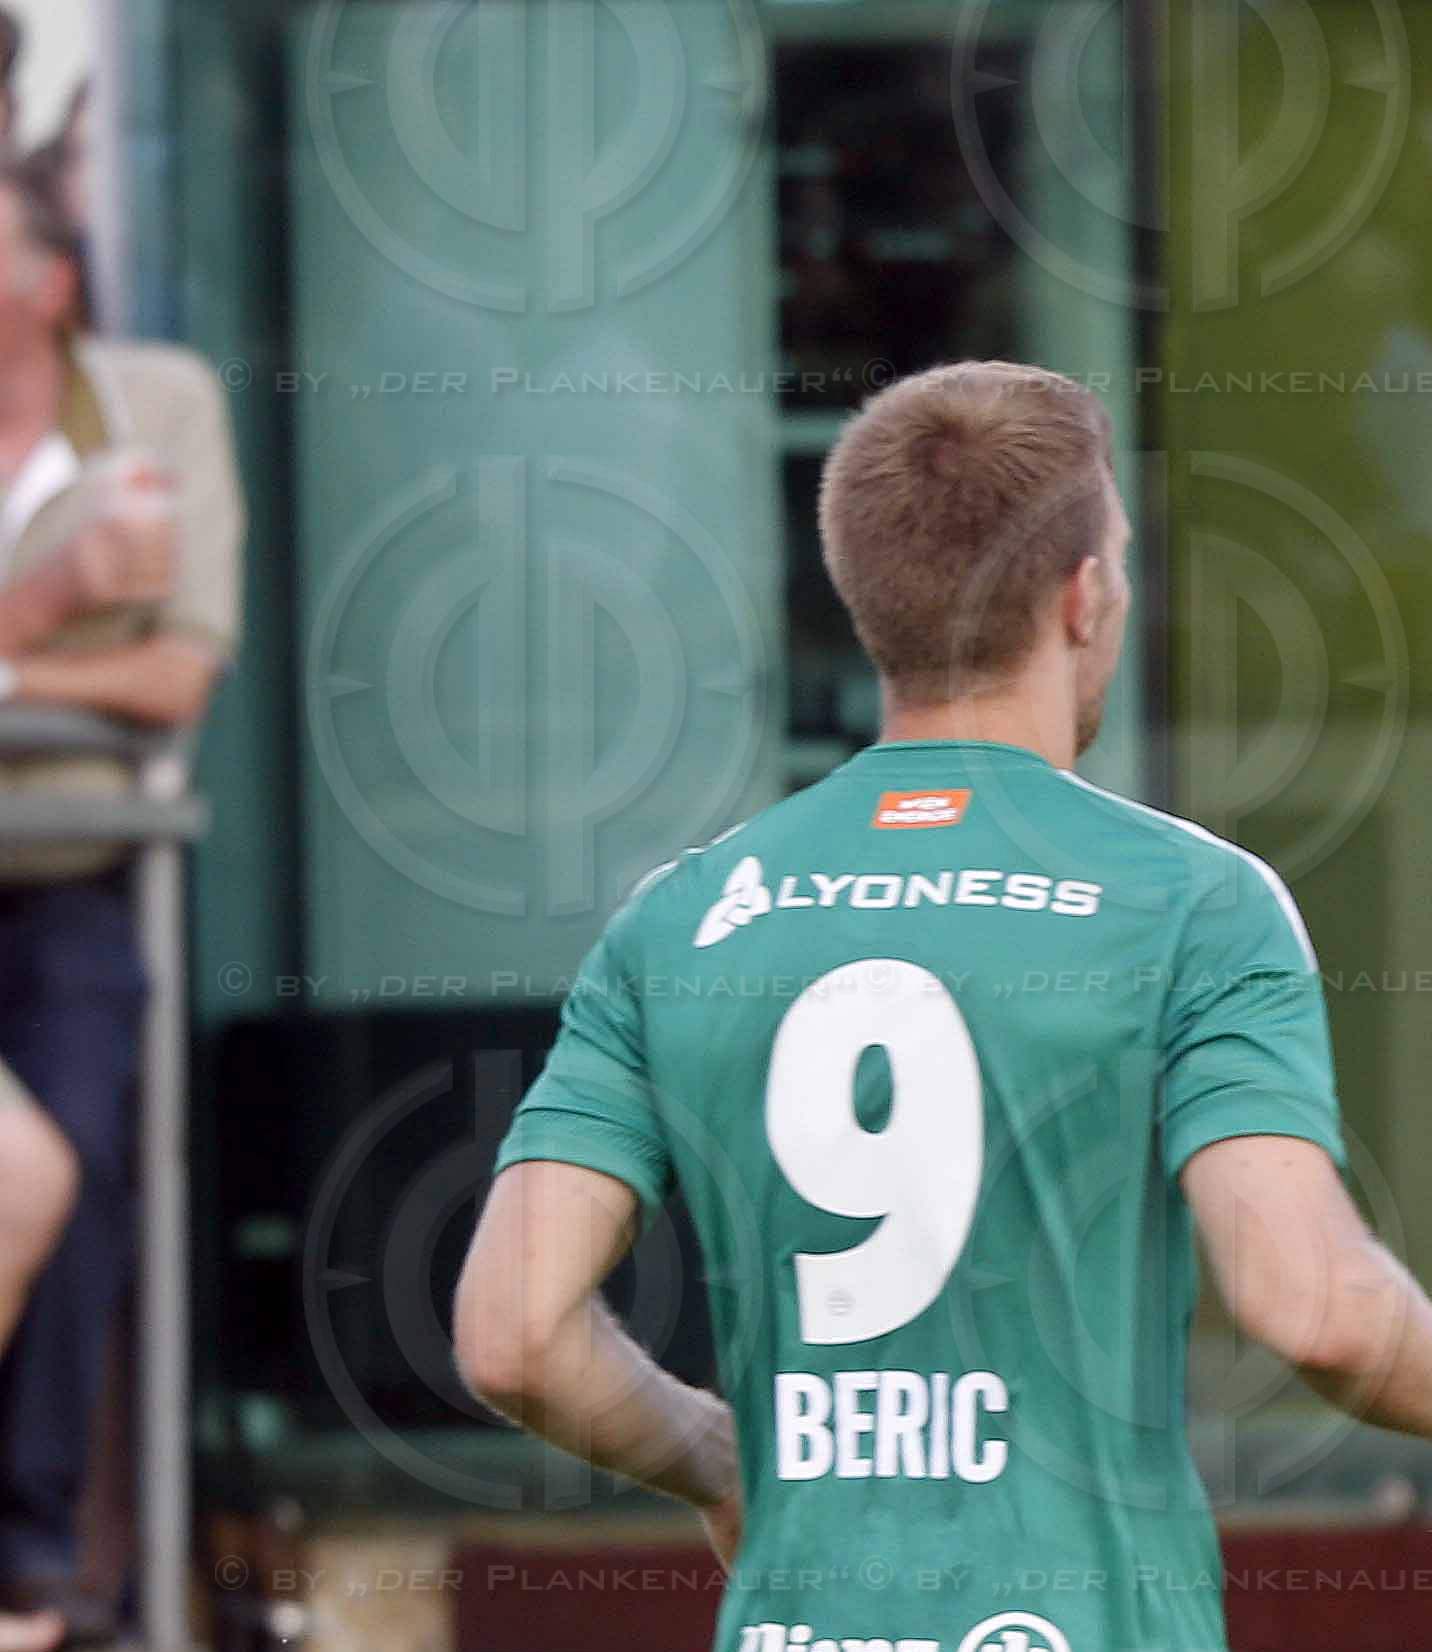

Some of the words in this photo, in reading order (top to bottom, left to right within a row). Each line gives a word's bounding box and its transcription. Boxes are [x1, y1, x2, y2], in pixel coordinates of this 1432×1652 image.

[776, 869, 1102, 916] LYONESS
[765, 958, 984, 1345] 9
[774, 1370, 1008, 1484] BERIC
